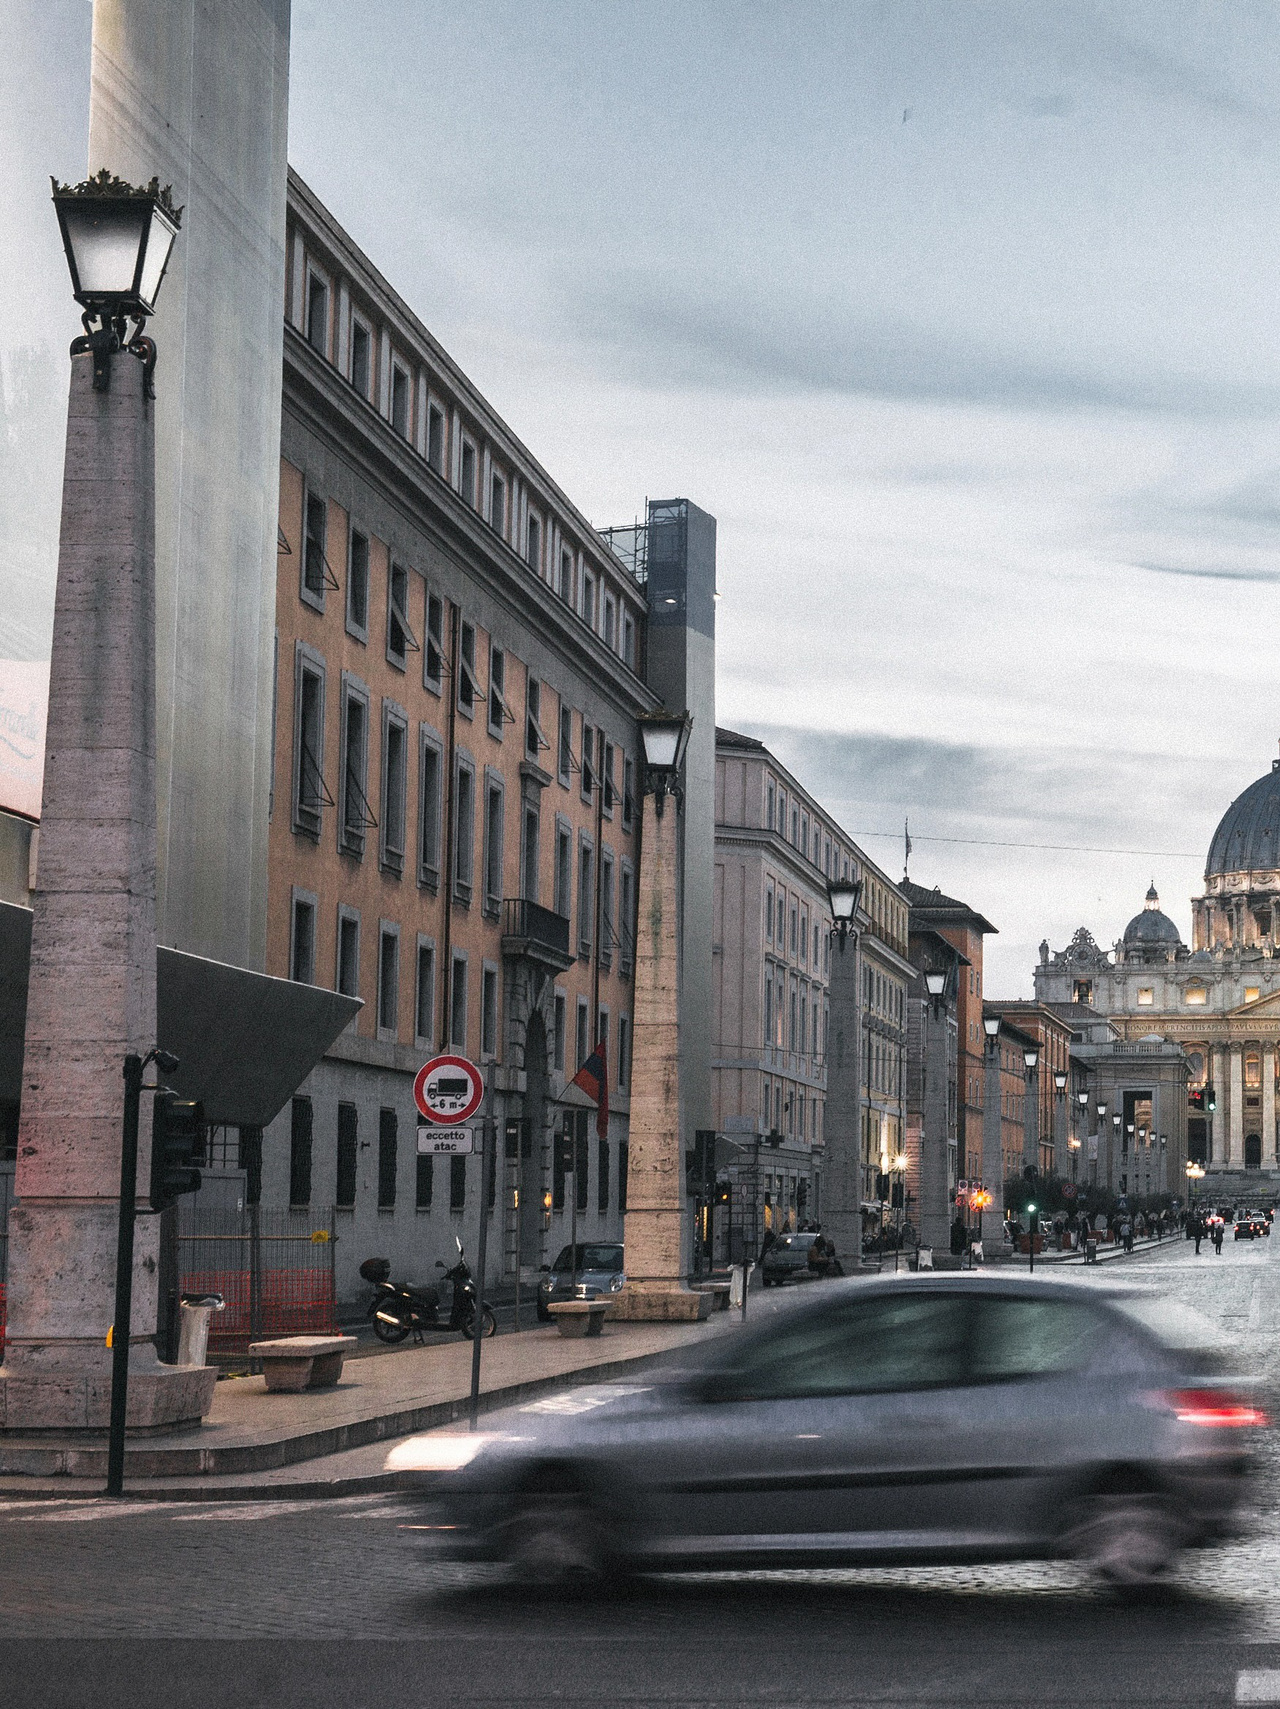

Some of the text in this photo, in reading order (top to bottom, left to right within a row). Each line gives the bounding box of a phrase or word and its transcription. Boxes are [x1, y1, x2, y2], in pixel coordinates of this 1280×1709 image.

[439, 1098, 457, 1109] 6 m
[426, 1131, 465, 1140] eccetto
[433, 1142, 457, 1151] atac
